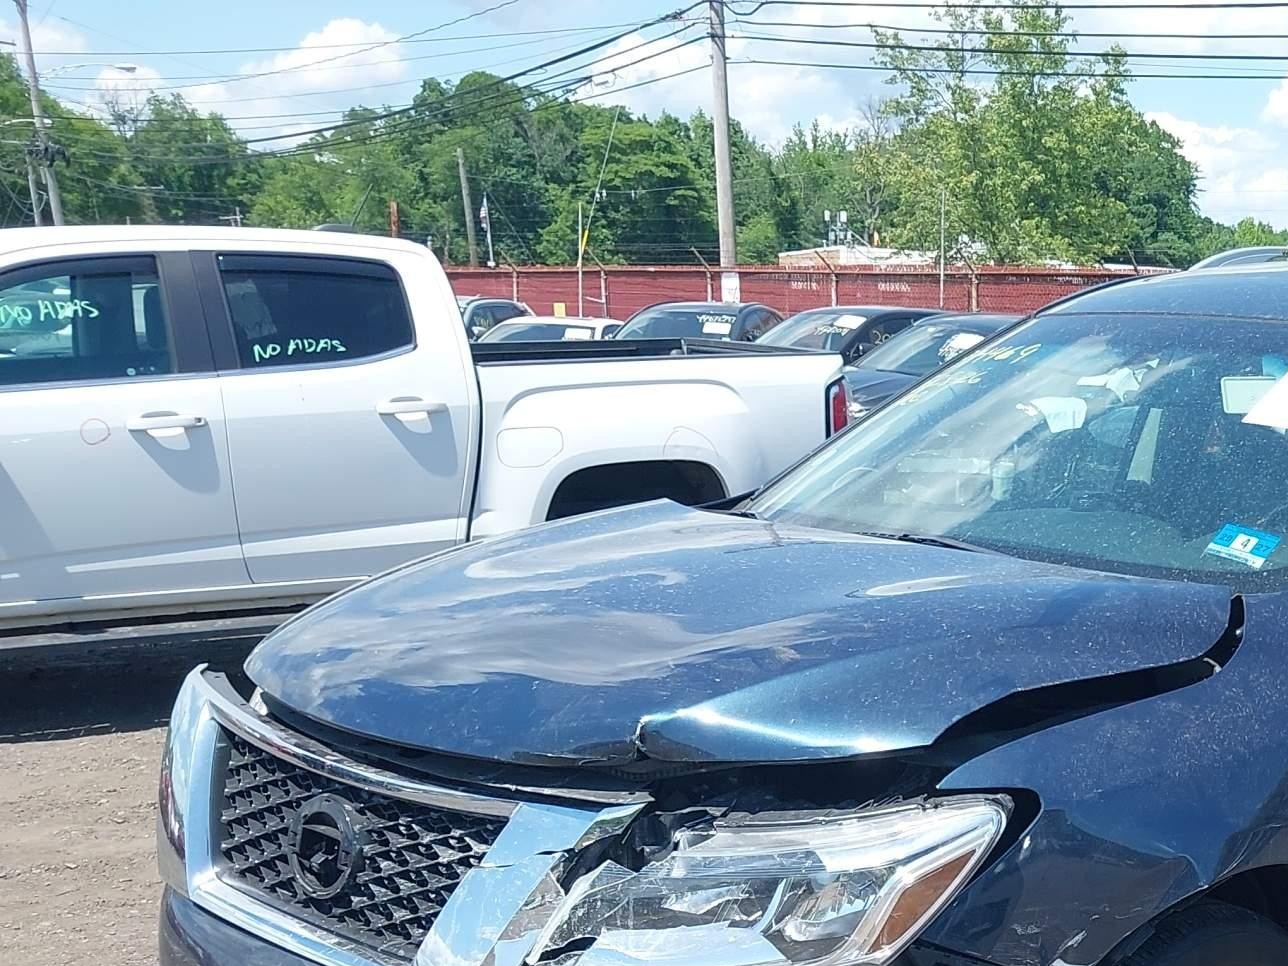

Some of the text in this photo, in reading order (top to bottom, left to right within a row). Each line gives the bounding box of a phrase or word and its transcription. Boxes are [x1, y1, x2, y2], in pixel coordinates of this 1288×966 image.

[0, 299, 99, 326] NO ADAS
[253, 338, 347, 362] NO ADAS
[1241, 538, 1251, 549] 4
